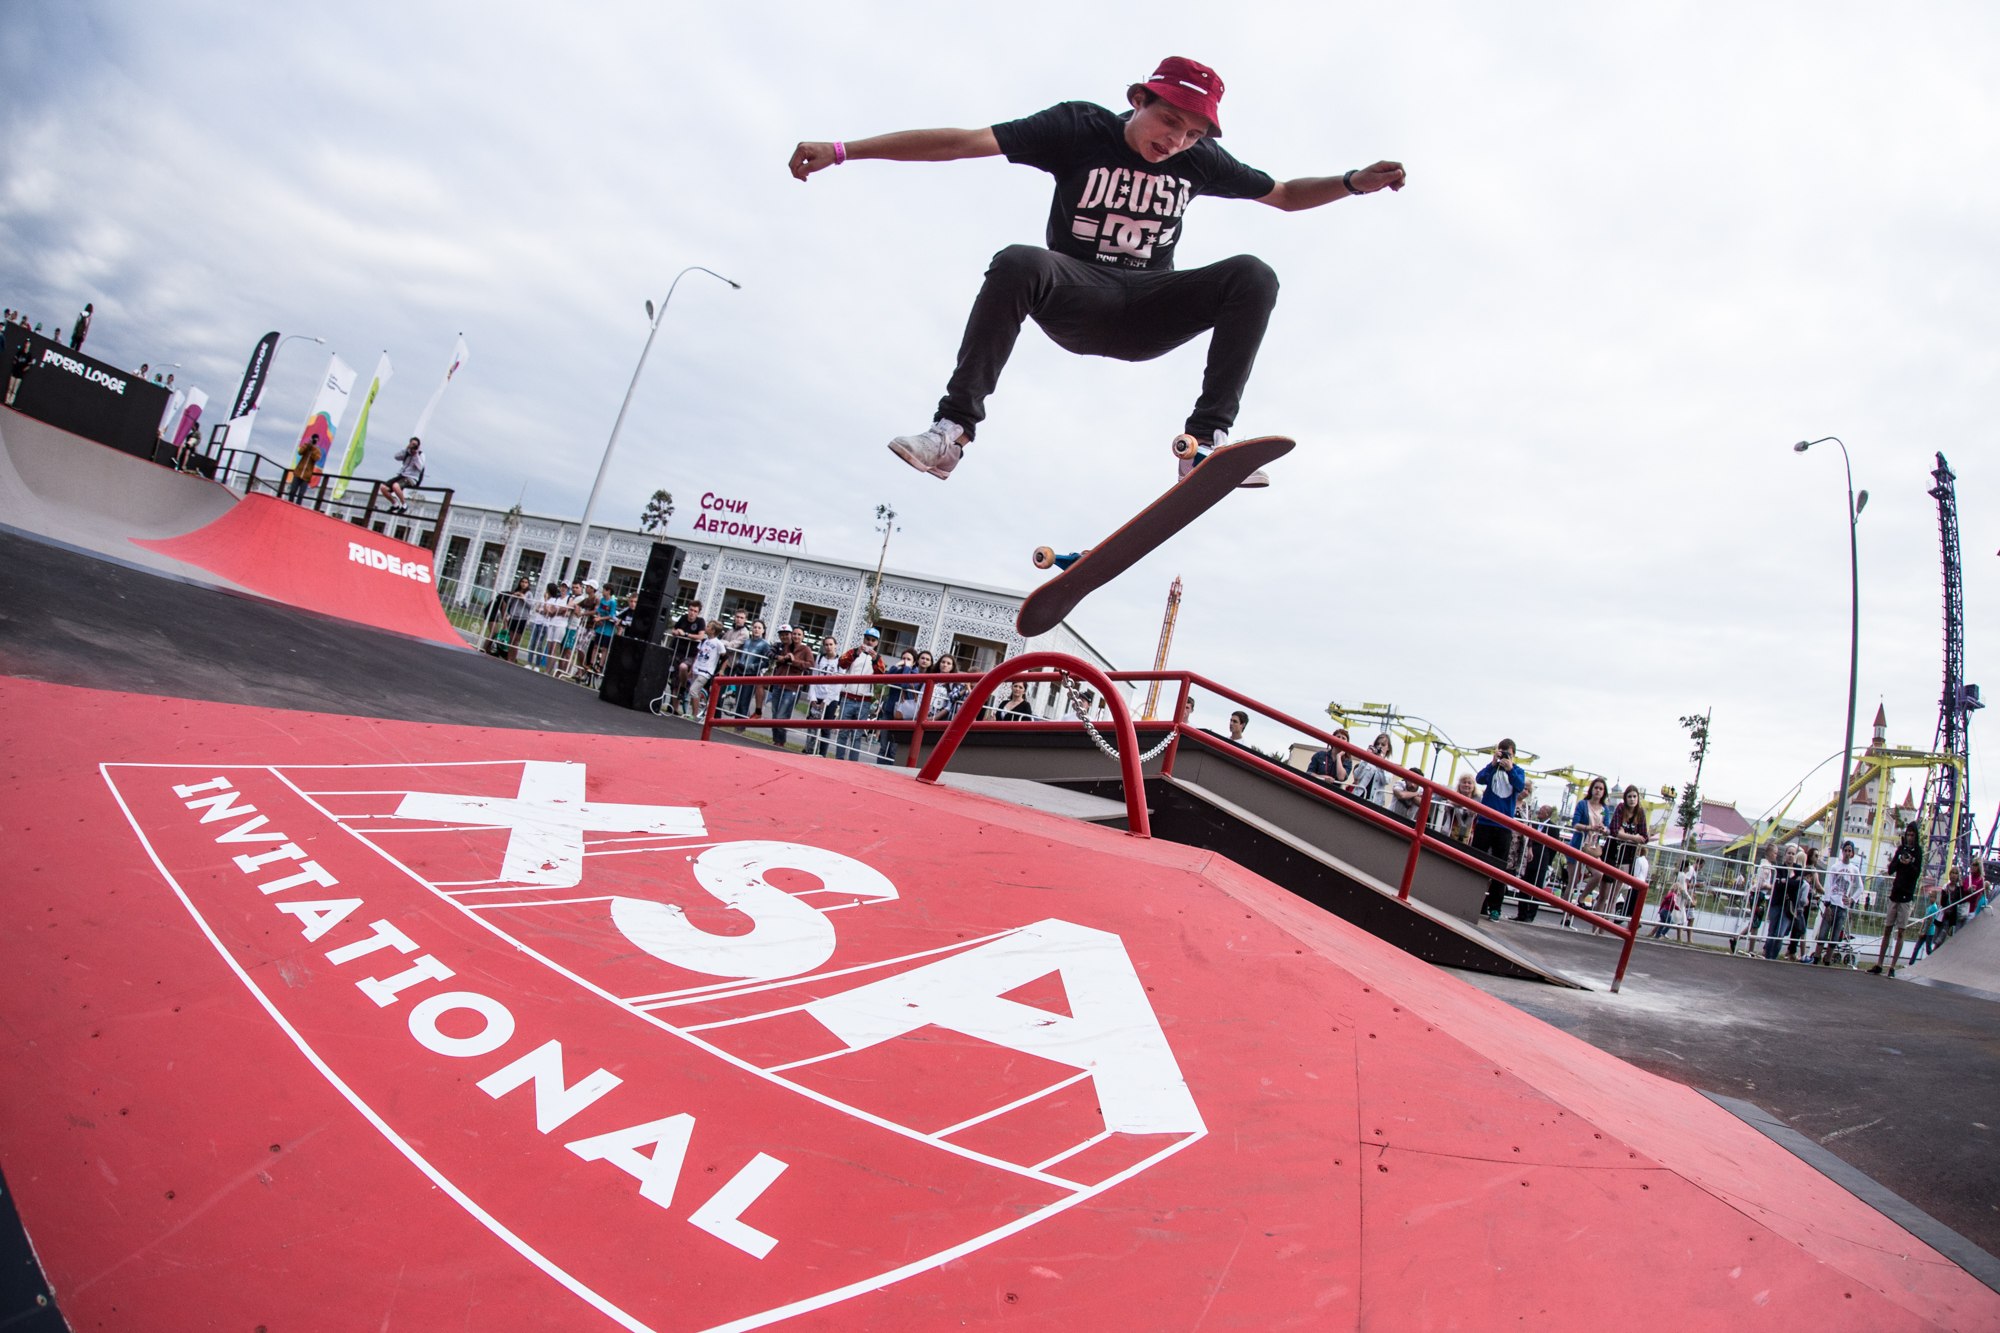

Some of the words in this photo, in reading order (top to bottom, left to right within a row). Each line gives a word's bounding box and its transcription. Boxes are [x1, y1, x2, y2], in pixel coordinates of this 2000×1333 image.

[42, 348, 85, 377] RIDERS
[84, 366, 127, 395] LODGE
[700, 492, 749, 514] Сочи
[693, 513, 803, 546] Автомузей
[347, 541, 432, 584] RIDERS
[171, 775, 790, 1260] INVITATIONAL
